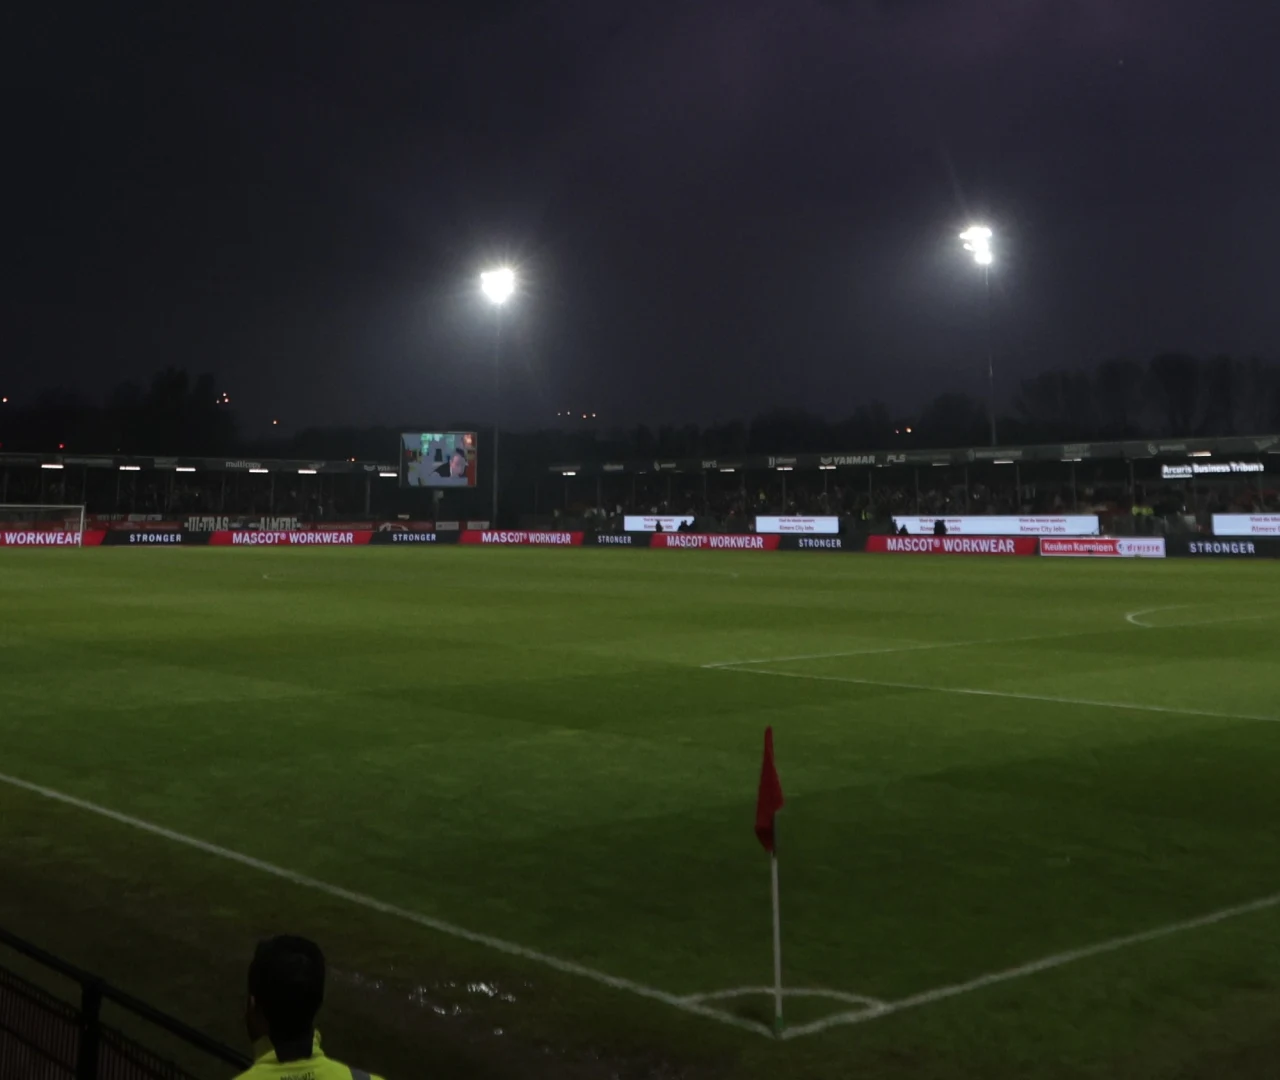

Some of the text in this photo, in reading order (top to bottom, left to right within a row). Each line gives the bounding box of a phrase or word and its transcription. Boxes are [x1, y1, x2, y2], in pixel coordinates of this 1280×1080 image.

[834, 456, 876, 465] YANMAR
[1193, 463, 1230, 473] Business
[4, 533, 83, 545] WORKWEAR
[129, 534, 182, 543] STRONGER
[289, 532, 354, 544] WORKWEAR
[392, 534, 436, 542] STRONGER
[528, 532, 571, 544] WORKWEAR
[597, 536, 632, 545] STRONGER
[709, 536, 763, 549] WORKWEAR
[798, 538, 842, 549] STRONGER
[942, 538, 1015, 554] WORKWEAR
[1044, 541, 1073, 554] Keuken
[1073, 541, 1114, 556] Kampioen
[1188, 541, 1256, 555] STRONGER
